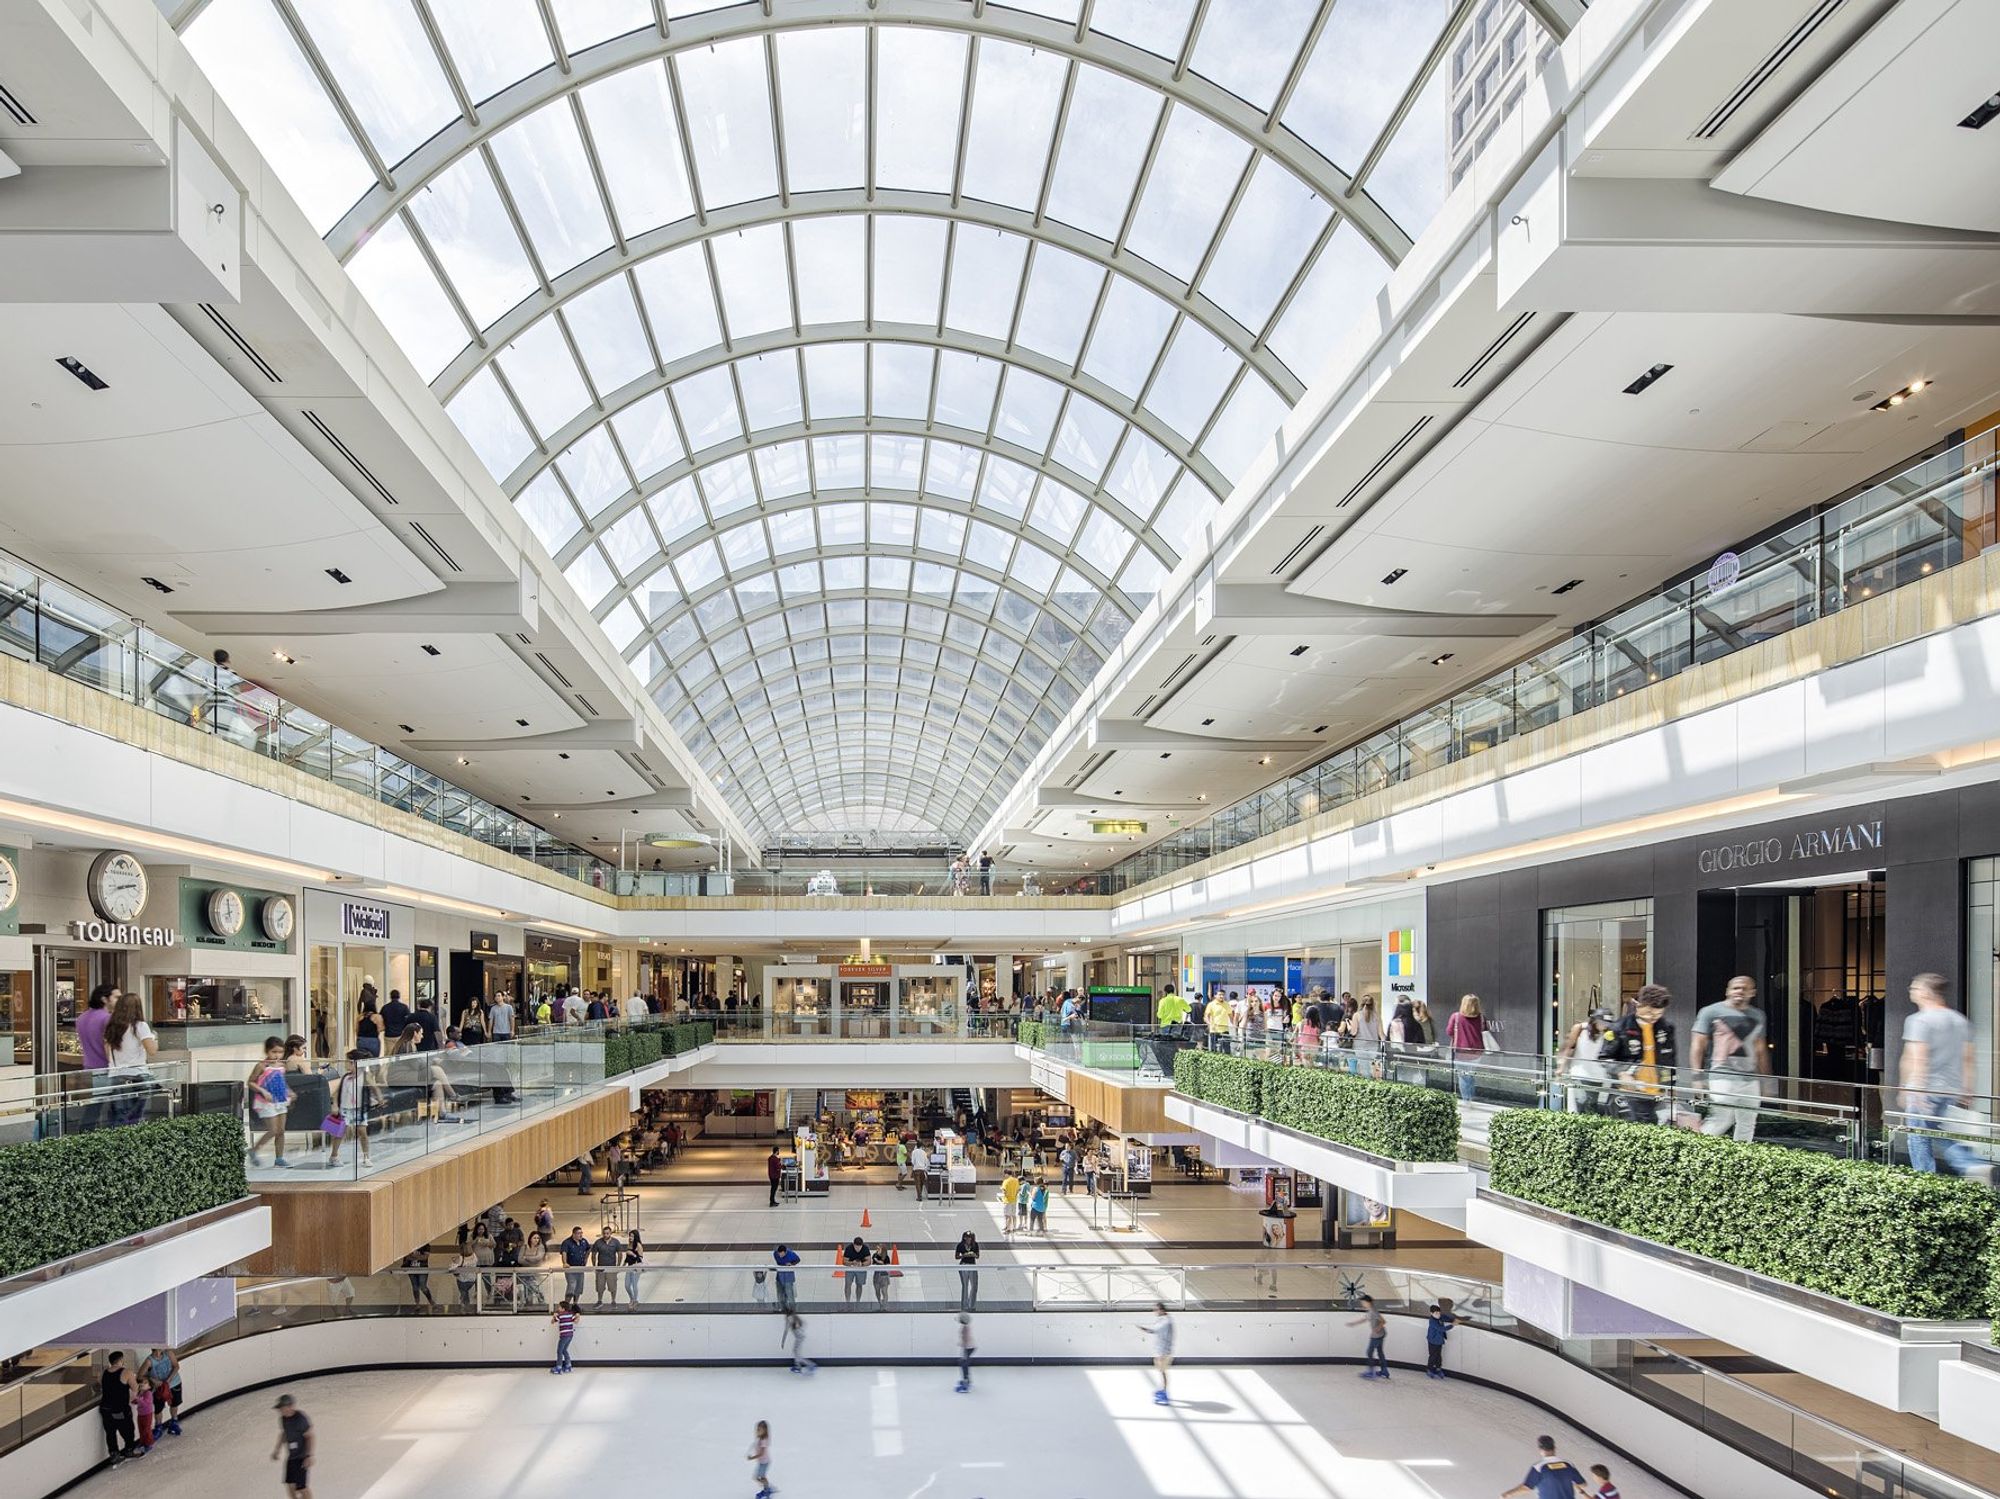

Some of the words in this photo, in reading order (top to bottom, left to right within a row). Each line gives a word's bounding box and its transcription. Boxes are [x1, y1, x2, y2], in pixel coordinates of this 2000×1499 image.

[1699, 837, 1782, 873] GIORGIO
[1789, 821, 1883, 860] ARMANI
[76, 920, 174, 947] TOURNEAU
[1391, 982, 1415, 991] Microsoft
